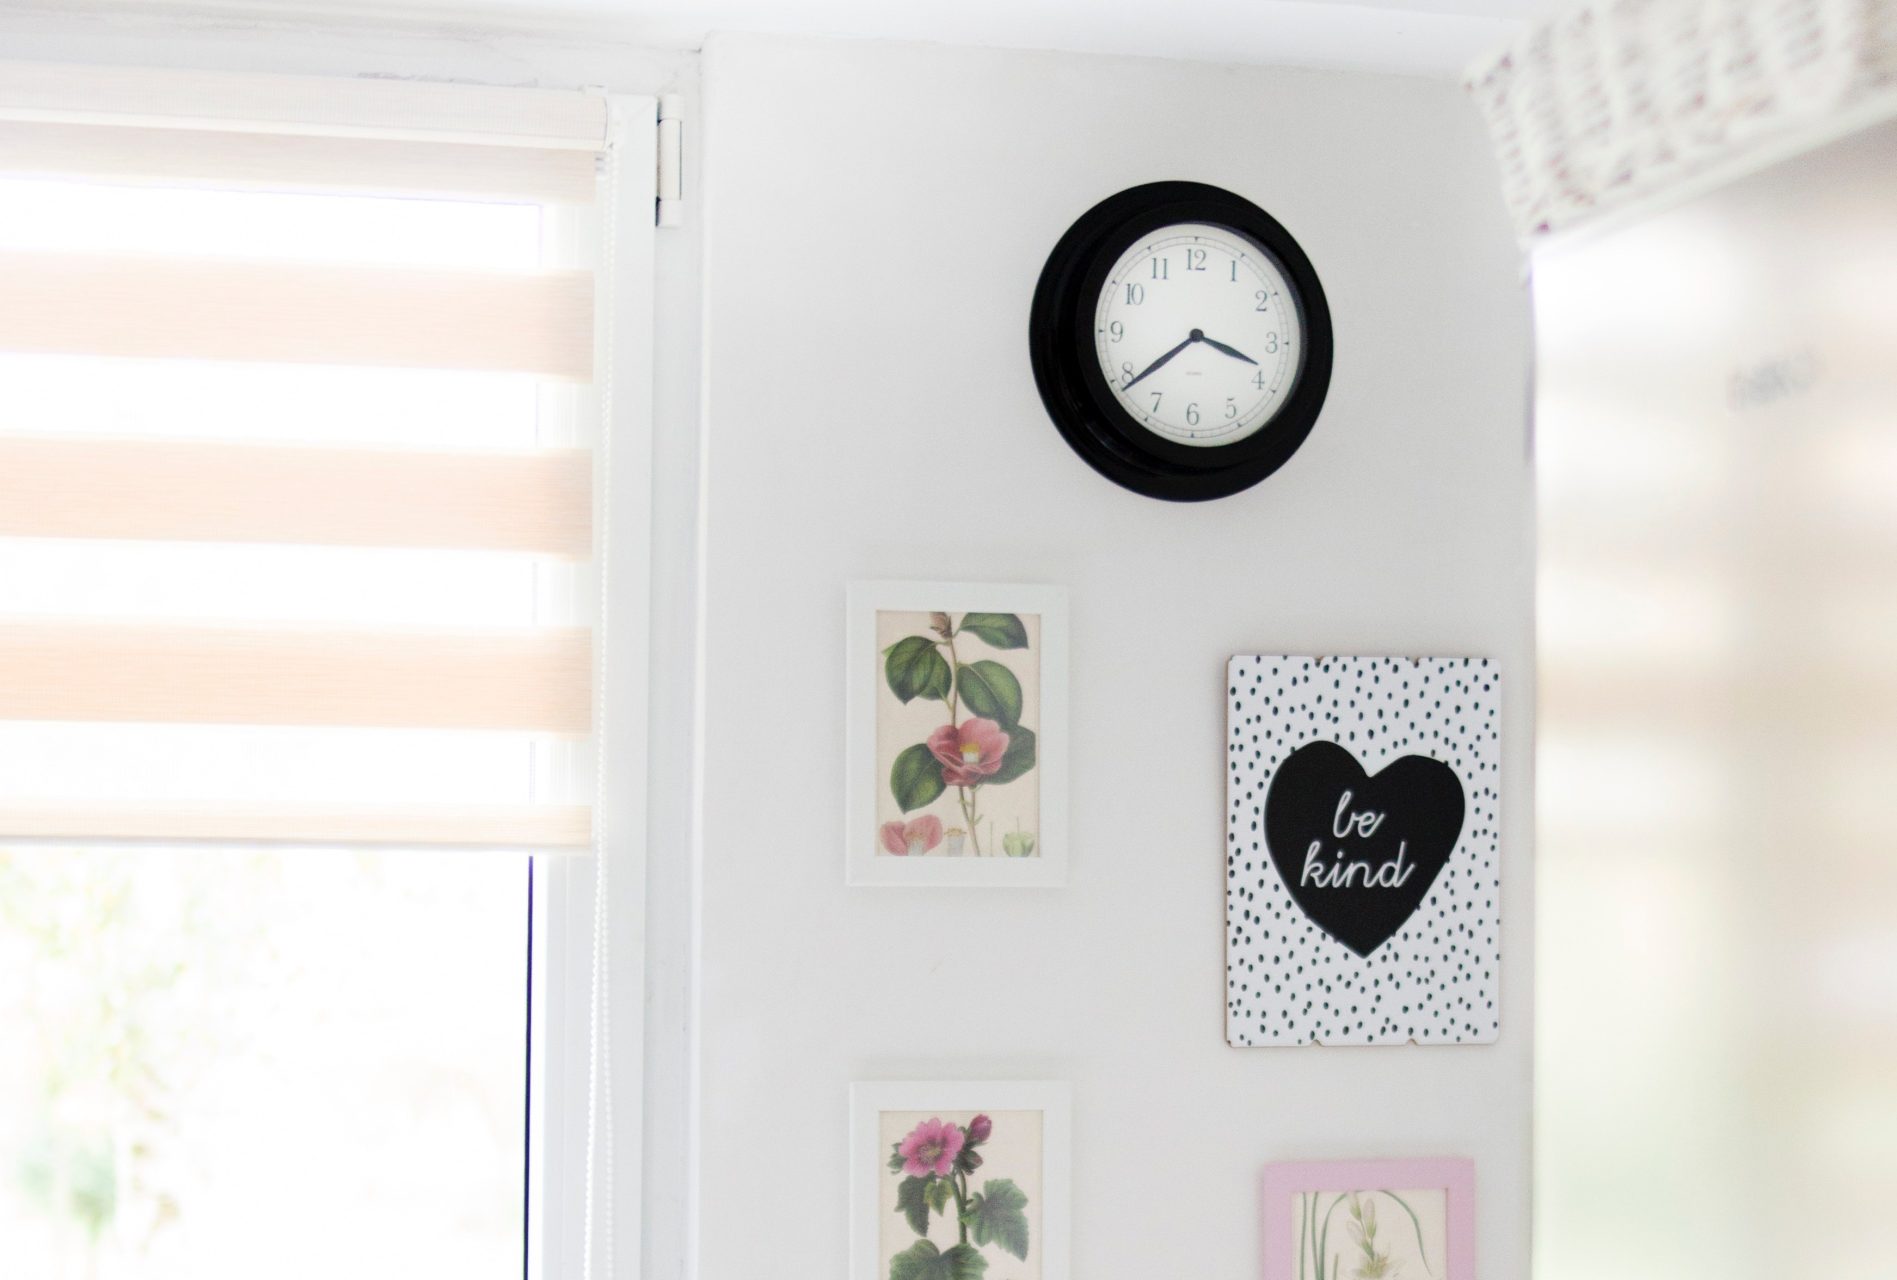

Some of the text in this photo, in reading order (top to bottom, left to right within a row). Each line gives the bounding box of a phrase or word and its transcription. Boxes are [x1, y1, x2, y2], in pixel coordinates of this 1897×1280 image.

[1152, 257, 1168, 280] 11
[1186, 248, 1206, 271] 12
[1230, 260, 1238, 282] 1
[1125, 283, 1144, 305] 10
[1255, 290, 1267, 312] 2
[1110, 321, 1123, 343] 9
[1265, 332, 1278, 354] 3
[1121, 362, 1134, 384] 8
[1251, 370, 1265, 390] 4
[1150, 392, 1162, 413] 7
[1225, 398, 1237, 419] 5
[1186, 403, 1199, 425] 6
[1332, 790, 1386, 839] be
[1300, 840, 1417, 889] kind
